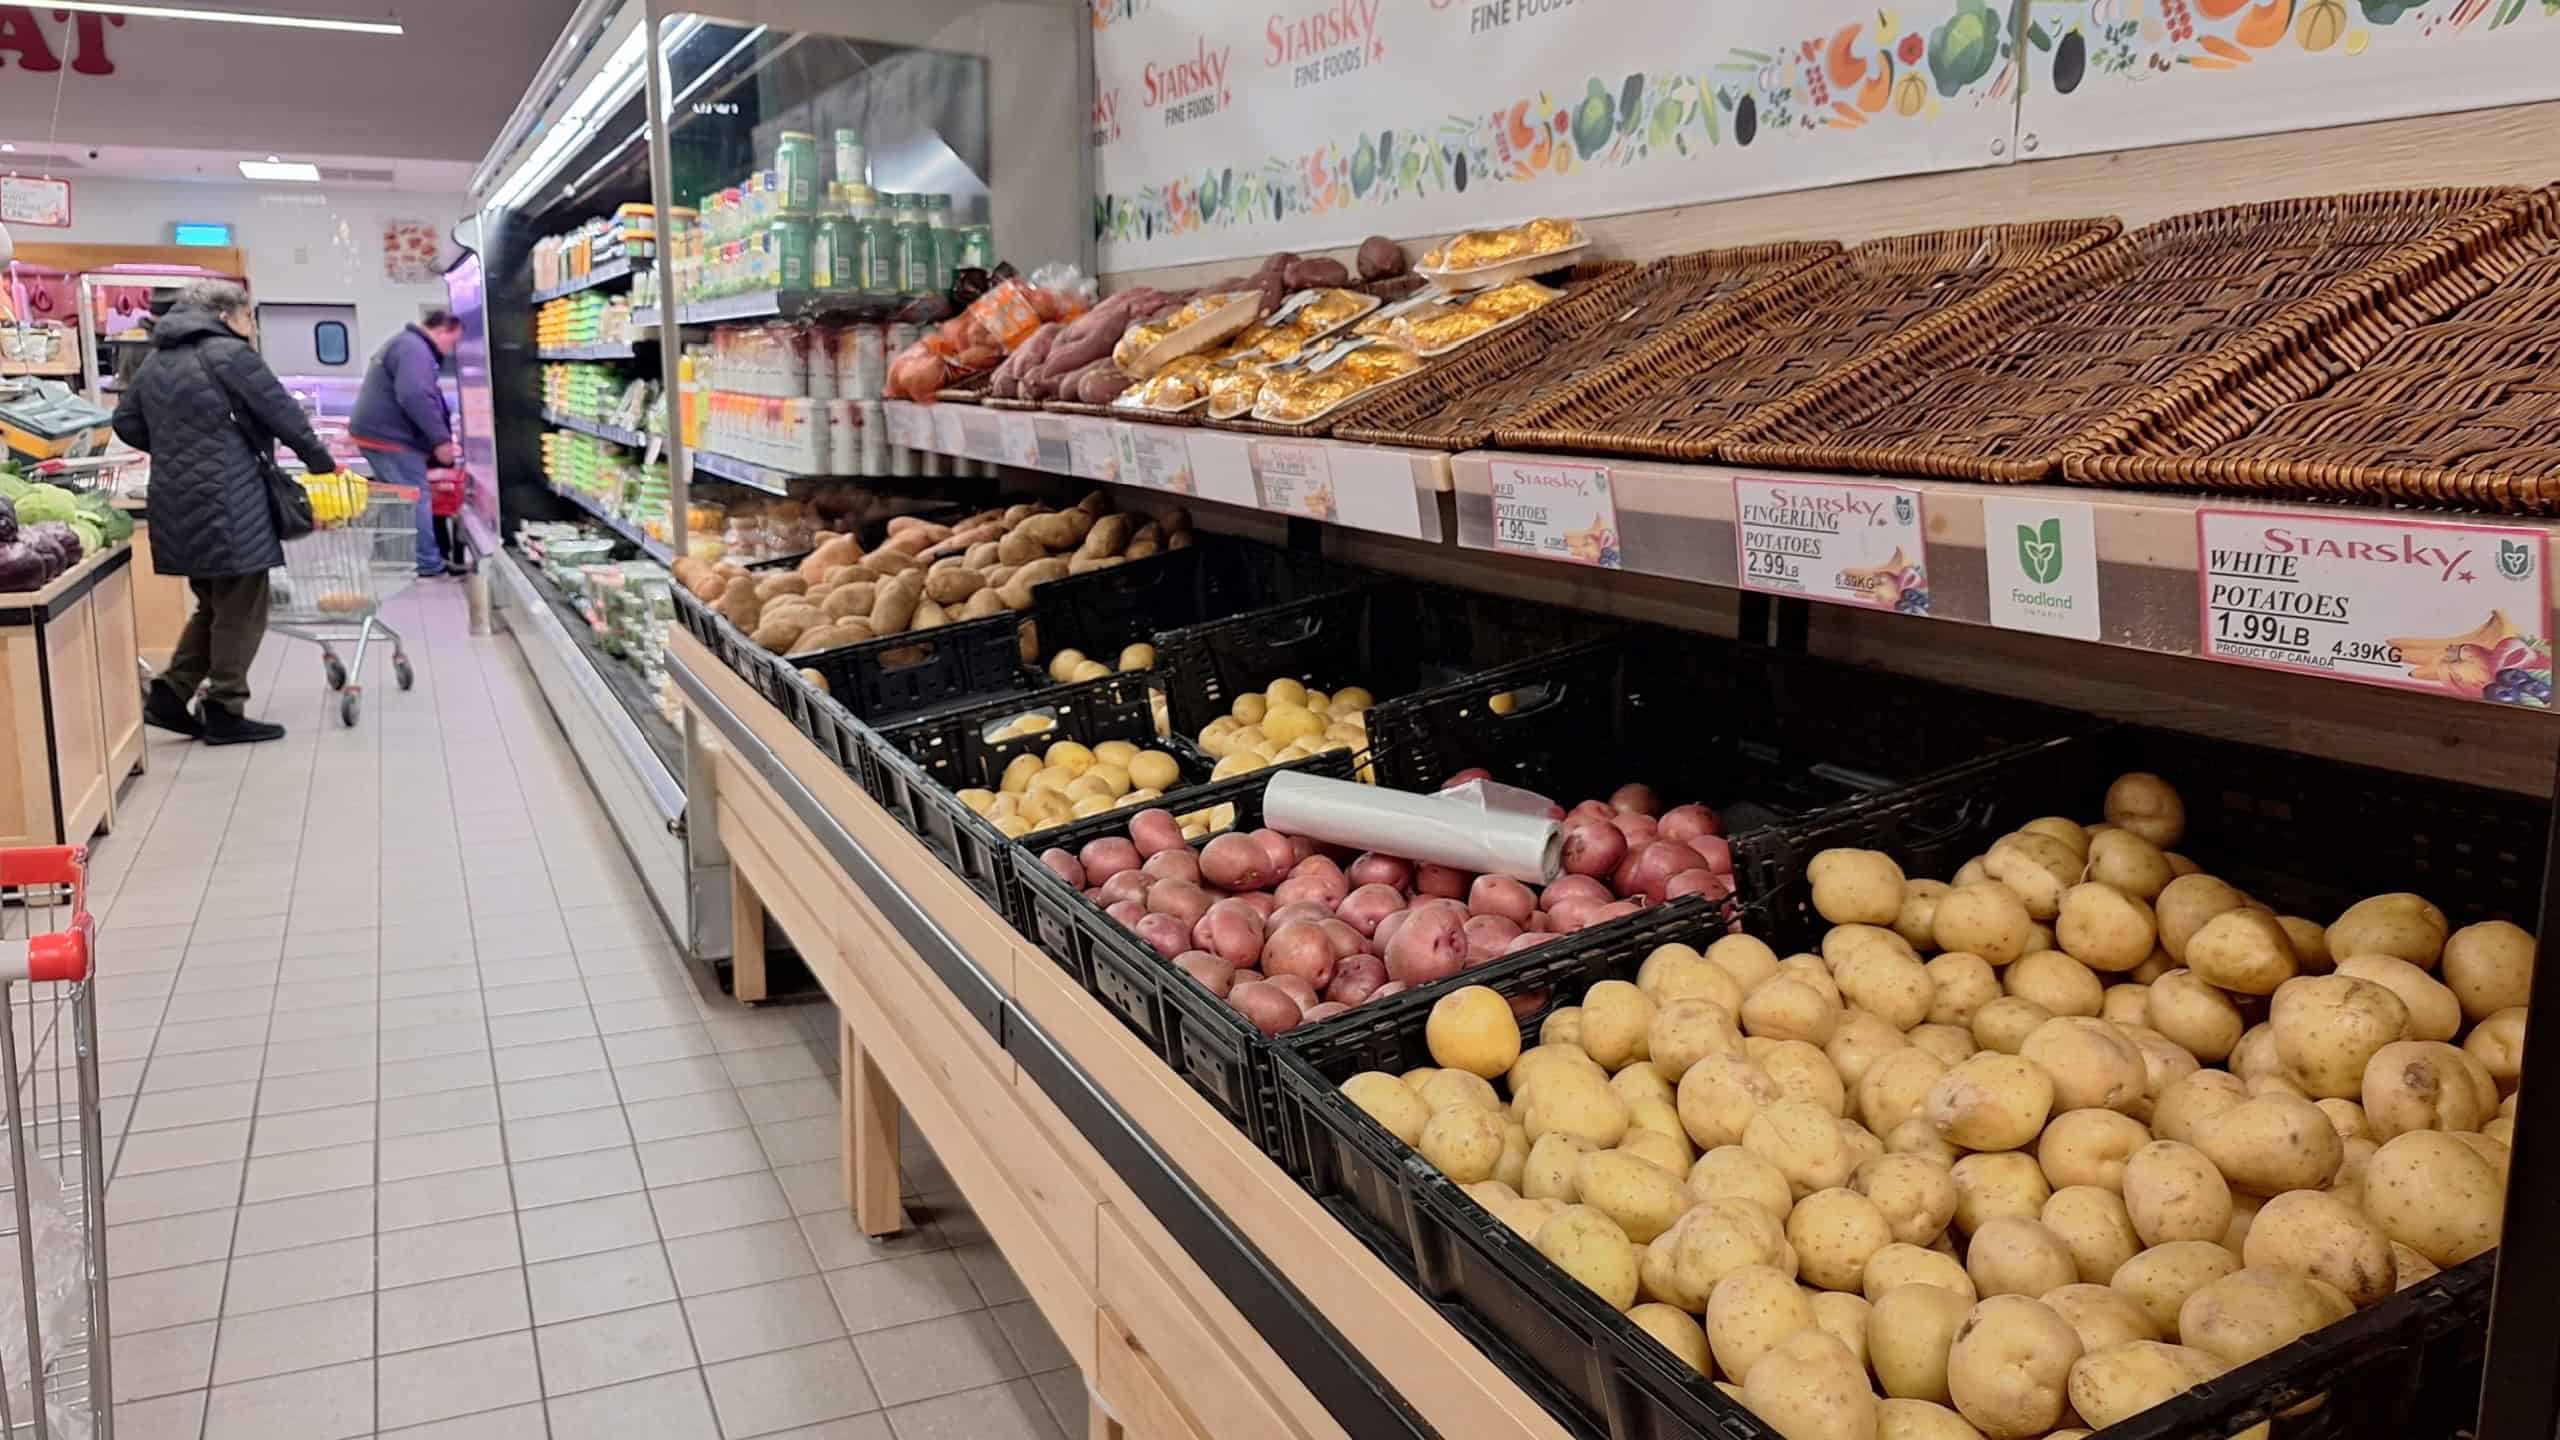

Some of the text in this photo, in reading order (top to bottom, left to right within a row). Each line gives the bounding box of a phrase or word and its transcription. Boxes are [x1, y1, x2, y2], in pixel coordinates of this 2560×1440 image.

[1470, 0, 1511, 35] FINE
[1294, 46, 1361, 88] FINE FOODS
[1164, 95, 1216, 128] FINE FOODS
[1495, 483, 1514, 496] RED
[1496, 503, 1547, 521] POTATOES
[1743, 504, 1839, 531] FINGERLING
[1745, 531, 1822, 556] POTATOES
[2210, 549, 2299, 578] WHITE
[2210, 584, 2350, 619] POTATOES
[2216, 643, 2335, 667] PRODUCT OF CANADA
[2331, 640, 2403, 664] 4.39KG
